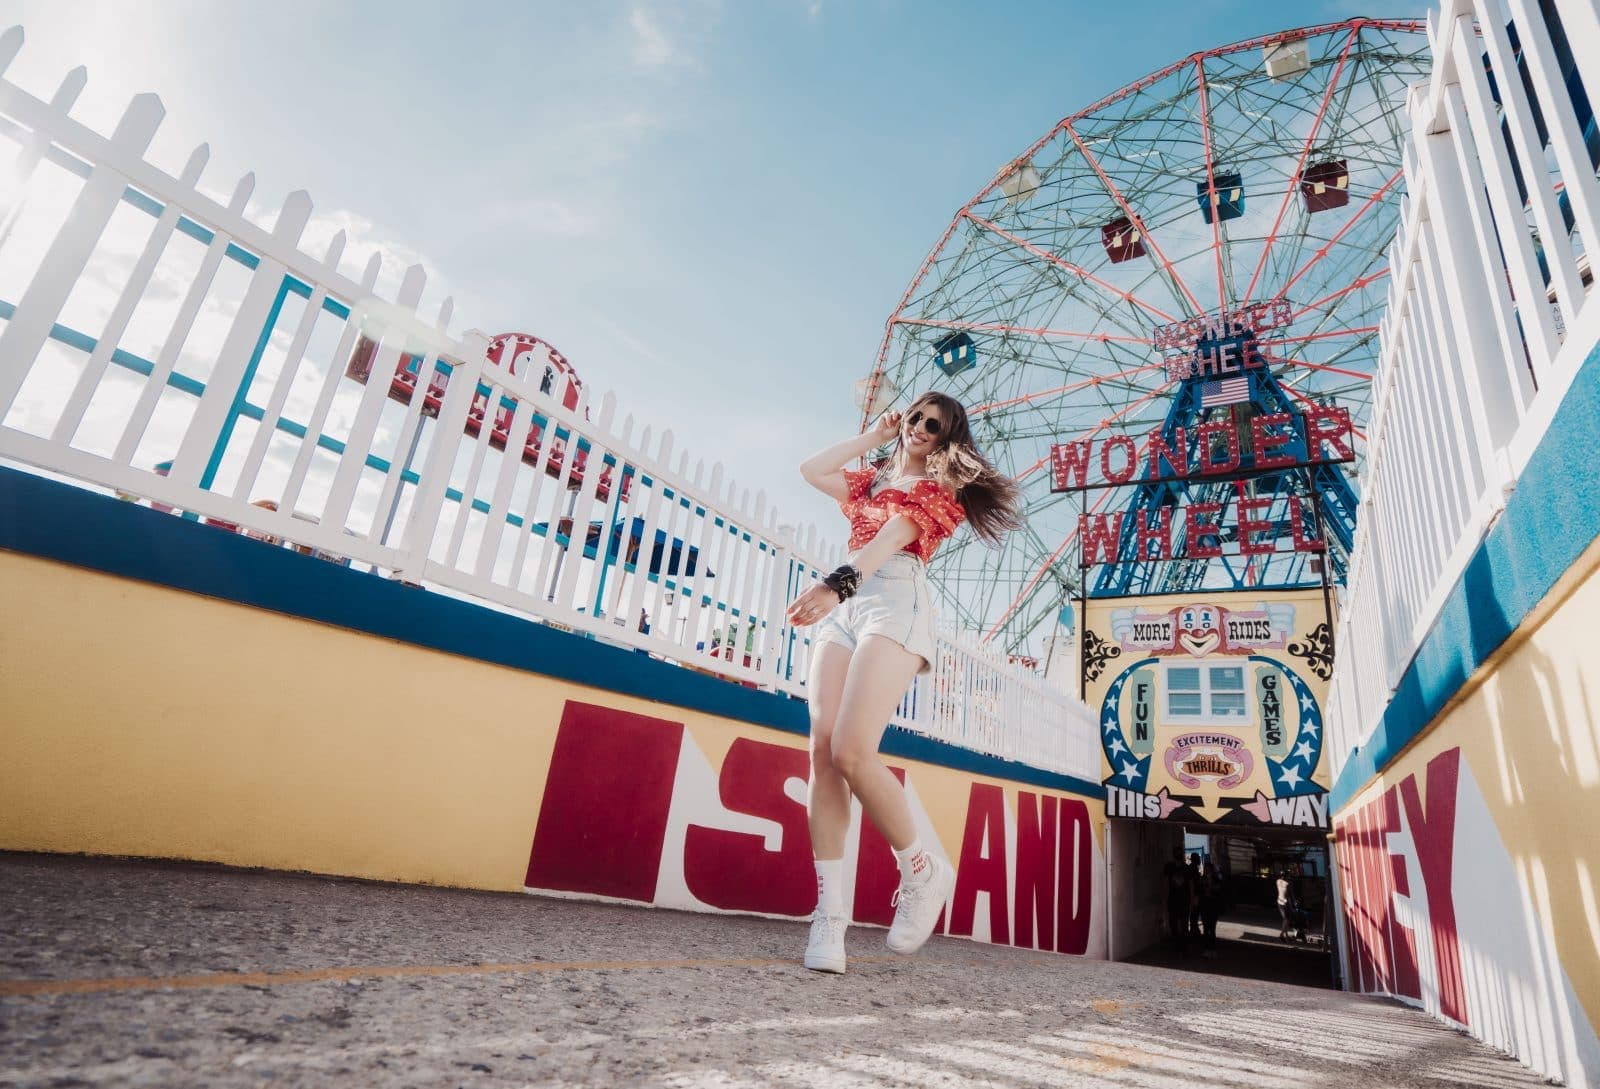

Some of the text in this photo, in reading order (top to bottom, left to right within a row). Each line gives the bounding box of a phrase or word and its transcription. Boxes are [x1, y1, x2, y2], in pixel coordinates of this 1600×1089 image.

[1154, 299, 1293, 349] WONDER
[1165, 337, 1287, 382] WHEEL
[1050, 406, 1354, 490] WONDER
[1078, 495, 1324, 565] WHEEL
[1133, 621, 1271, 641] MORE RIDES
[1136, 684, 1148, 741] FUN
[1262, 675, 1281, 745] GAMES
[1177, 735, 1241, 749] EXCITEMENT
[1185, 760, 1231, 776] THRILLS
[1105, 784, 1330, 828] THIS WAY
